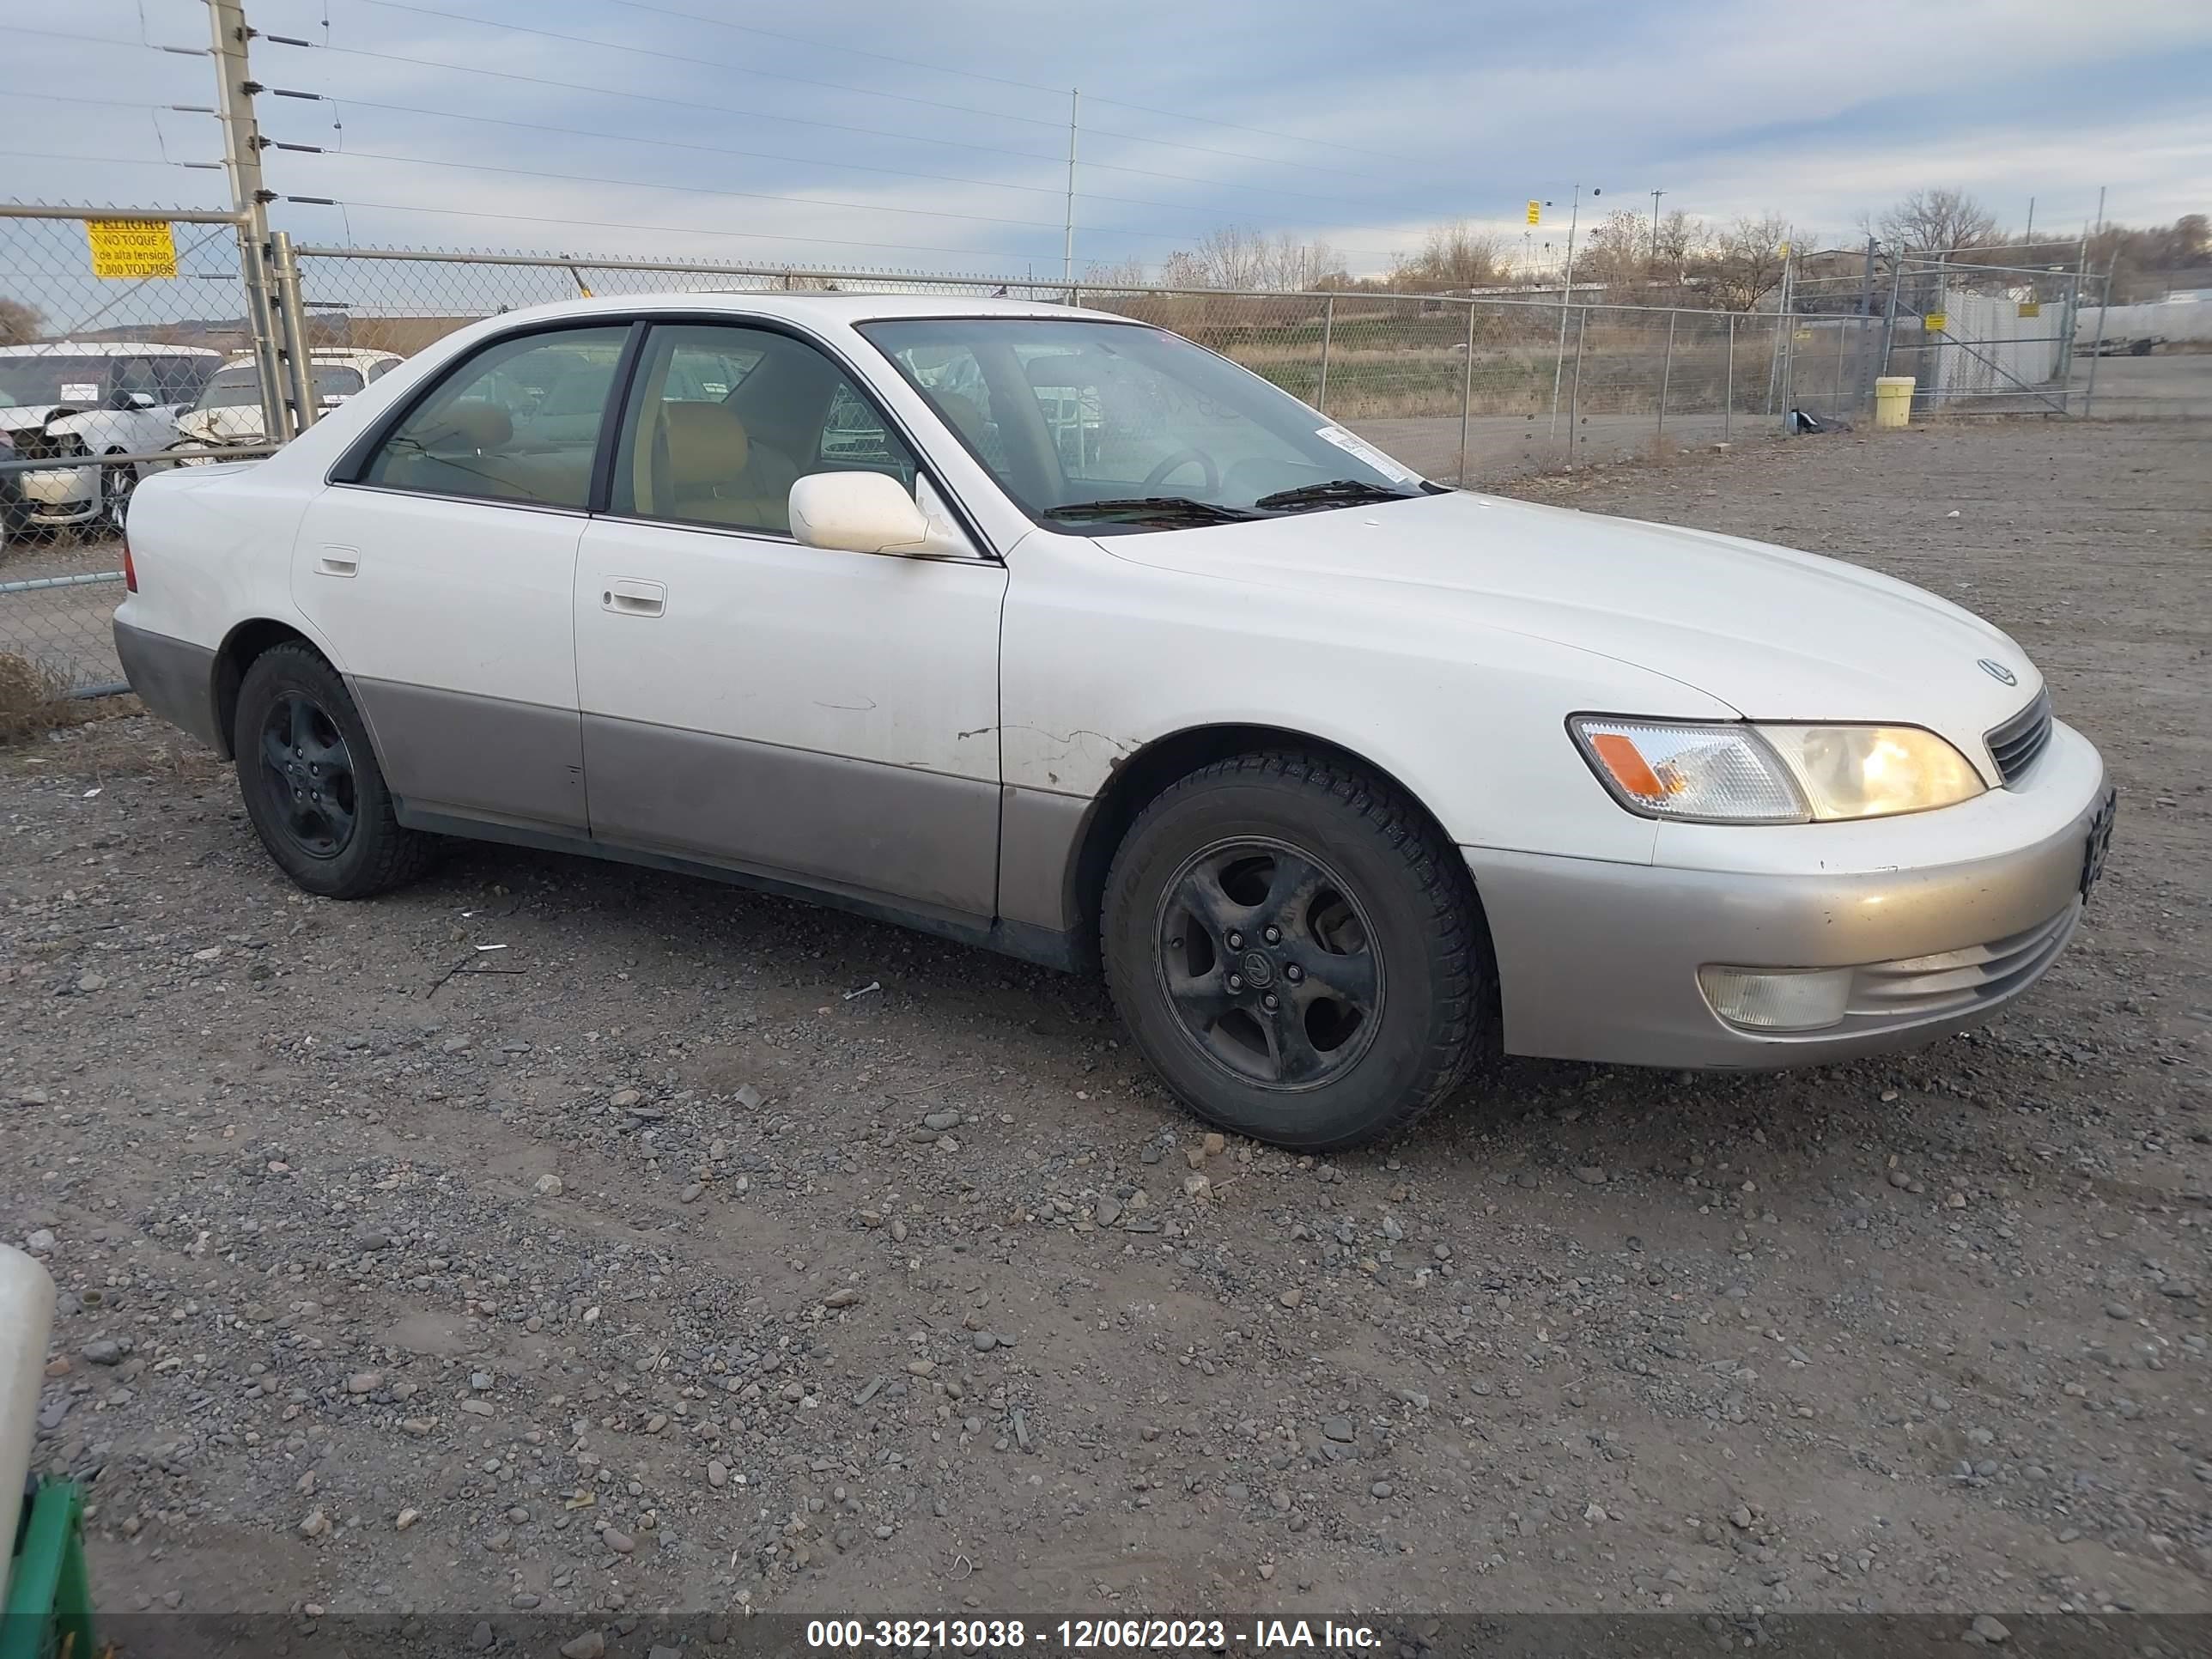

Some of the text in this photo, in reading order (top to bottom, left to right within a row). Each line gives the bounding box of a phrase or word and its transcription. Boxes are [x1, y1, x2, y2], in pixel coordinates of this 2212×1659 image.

[90, 219, 167, 230] PELIGRO
[104, 234, 158, 246] NO TOQUE
[114, 249, 131, 260] alta
[134, 249, 170, 260] tension
[125, 263, 174, 275] VOLTIOS
